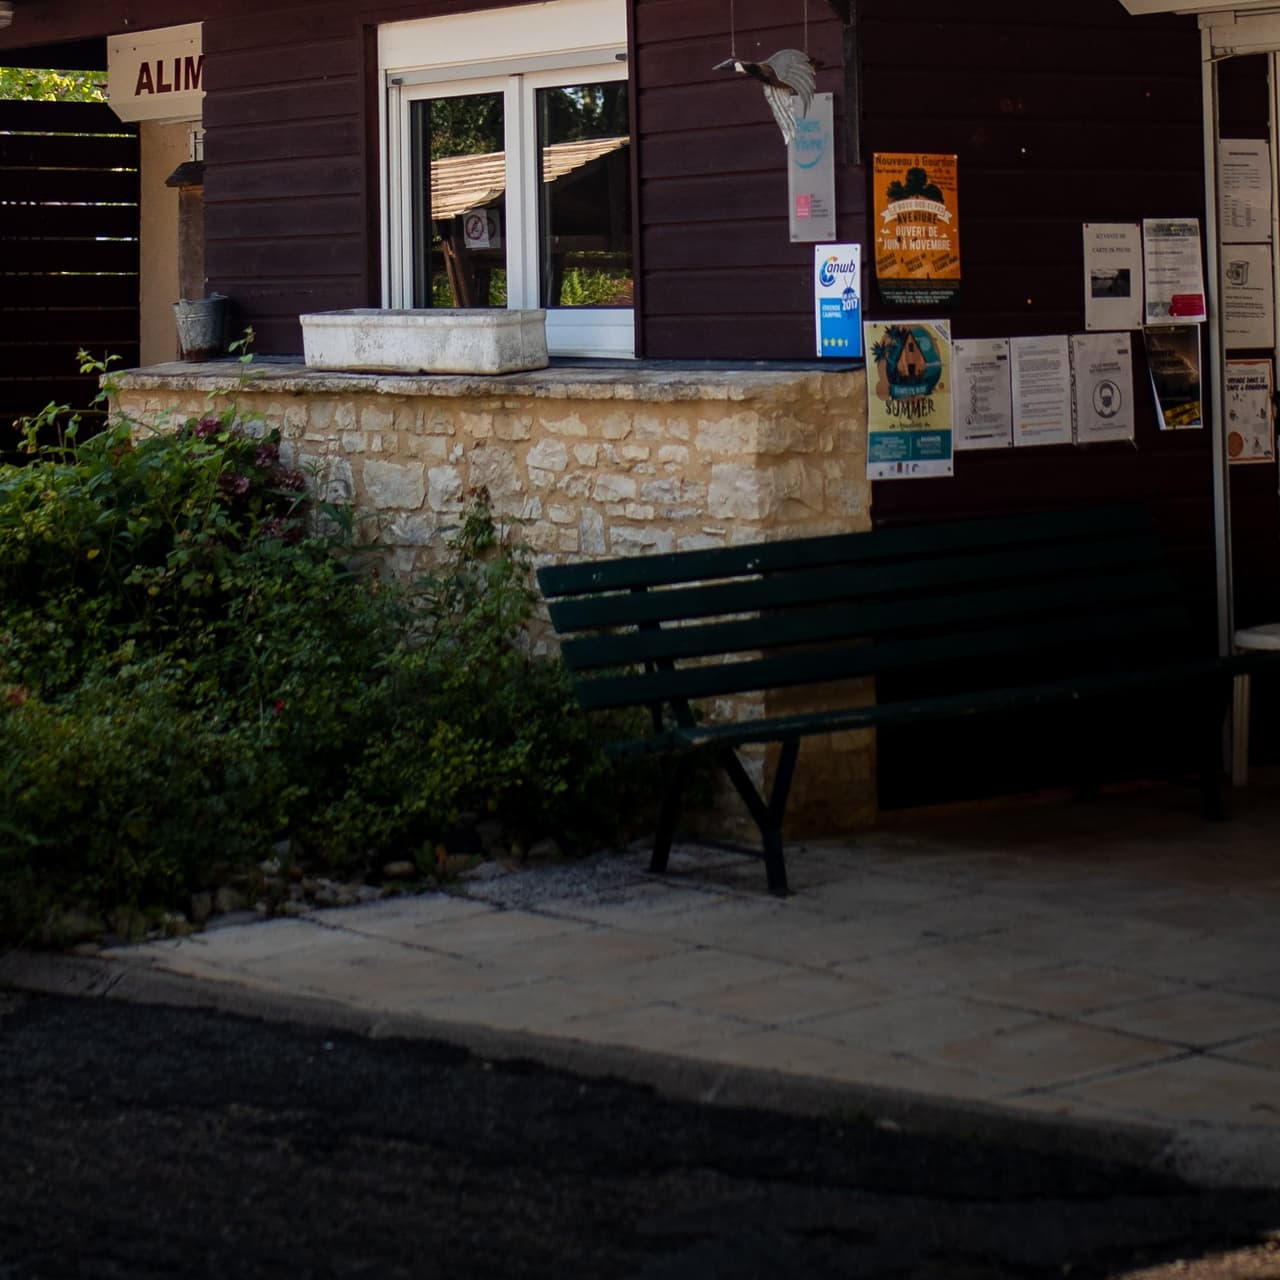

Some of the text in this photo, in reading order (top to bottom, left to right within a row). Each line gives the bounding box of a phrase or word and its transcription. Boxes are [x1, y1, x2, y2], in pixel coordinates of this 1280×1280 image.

[135, 55, 206, 97] ALIM
[895, 225, 939, 238] OUVERT DE
[883, 239, 900, 251] JUIN
[908, 239, 952, 252] NOVEMBRE
[826, 258, 856, 273] anwb
[841, 300, 858, 312] 2017
[885, 397, 937, 419] SUMMER
